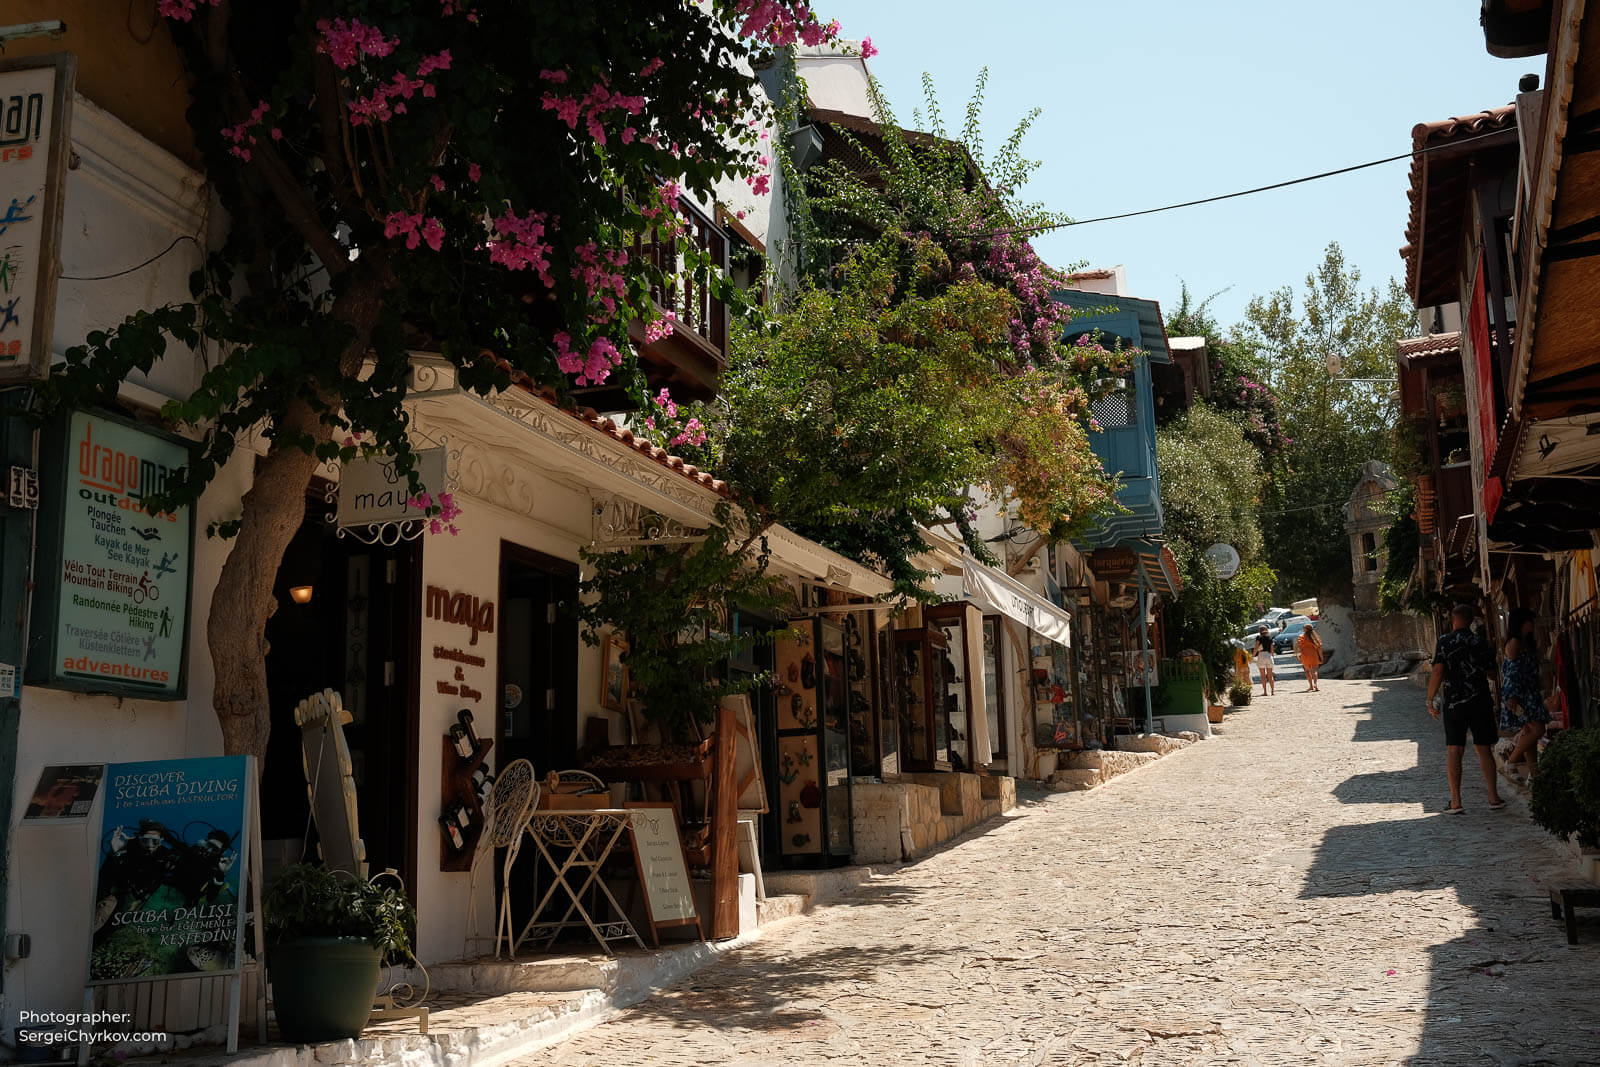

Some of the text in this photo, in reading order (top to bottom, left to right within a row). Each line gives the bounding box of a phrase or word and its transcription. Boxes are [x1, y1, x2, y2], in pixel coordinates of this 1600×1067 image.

[0, 94, 43, 145] an
[79, 421, 179, 499] dragoma
[14, 477, 38, 497] 15
[79, 489, 177, 523] outdors
[354, 489, 410, 514] may
[87, 505, 121, 524] Plongée
[91, 518, 126, 536] Tauchen
[95, 535, 150, 556] Kayak de Mer
[108, 549, 150, 568] See Kayak
[64, 559, 138, 584] Vélo Tout Terrain
[64, 571, 133, 597] Mountain Biking
[73, 594, 158, 619] Randonnée Pédestre
[425, 584, 495, 646] maya
[65, 623, 109, 641] Traversée
[129, 616, 154, 632] Hiking
[63, 656, 169, 682] adventures
[454, 665, 465, 681] &
[436, 680, 459, 695] Wine
[113, 771, 185, 787] DISCOVER
[115, 778, 239, 800] SCUBA DIVING
[111, 903, 233, 926] SCUBA DALIŞI
